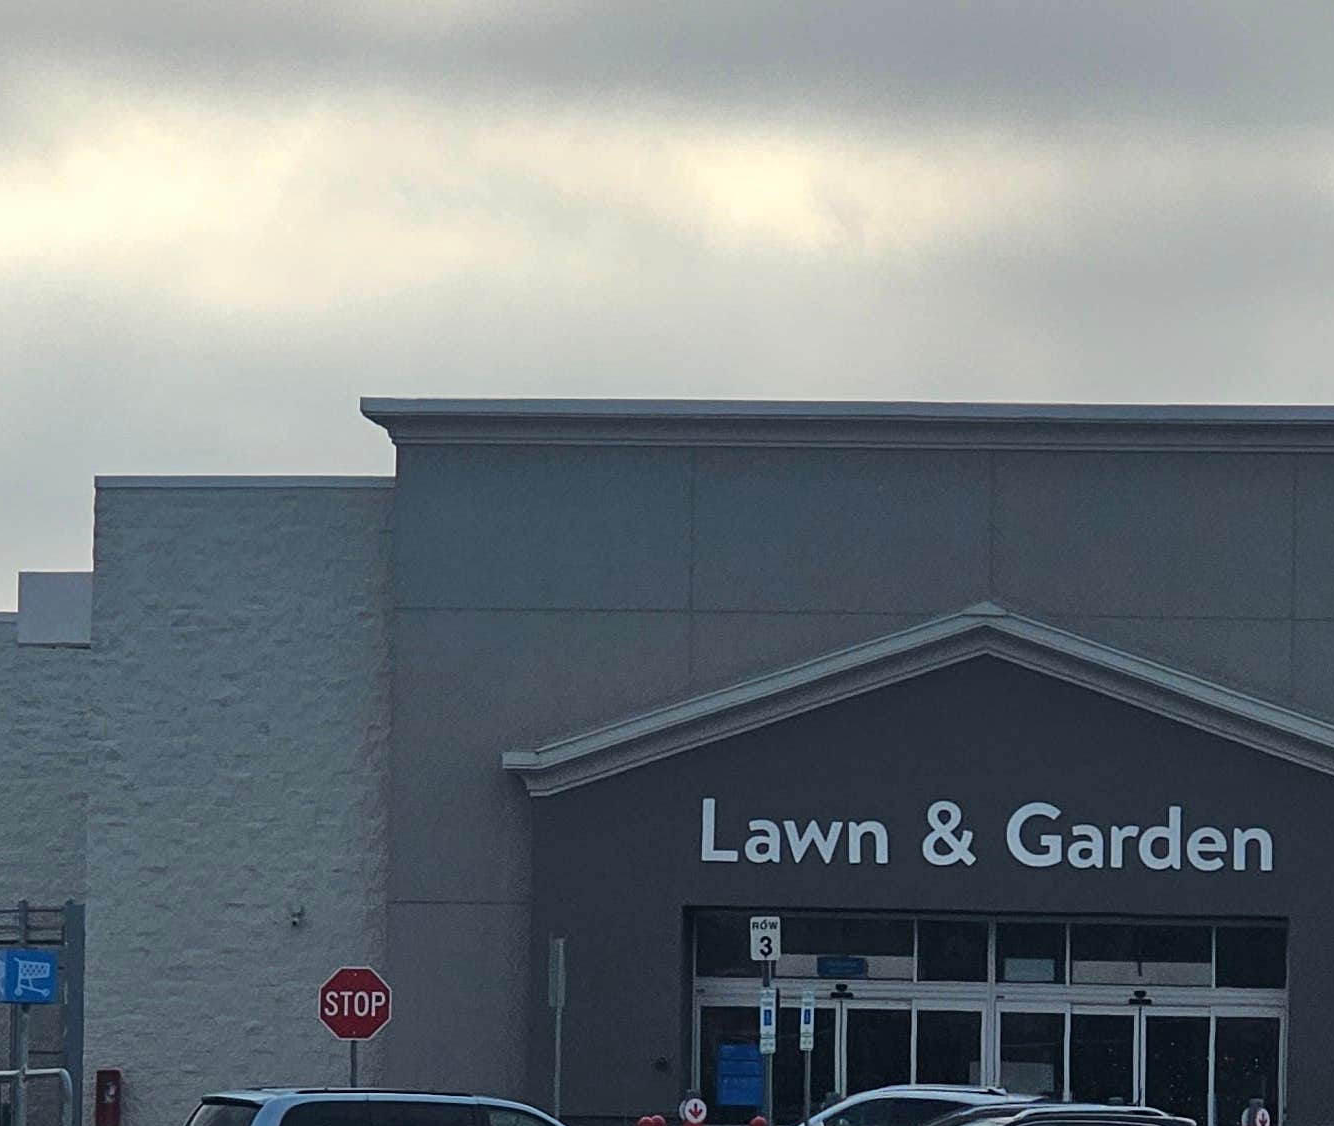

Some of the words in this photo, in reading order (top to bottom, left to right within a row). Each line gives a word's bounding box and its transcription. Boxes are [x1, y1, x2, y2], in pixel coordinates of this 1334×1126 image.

[700, 797, 889, 865] Lawn
[921, 800, 977, 867] &
[1005, 801, 1274, 872] Garden
[752, 920, 779, 930] ROW
[759, 935, 773, 957] 3
[324, 990, 386, 1017] STOP
